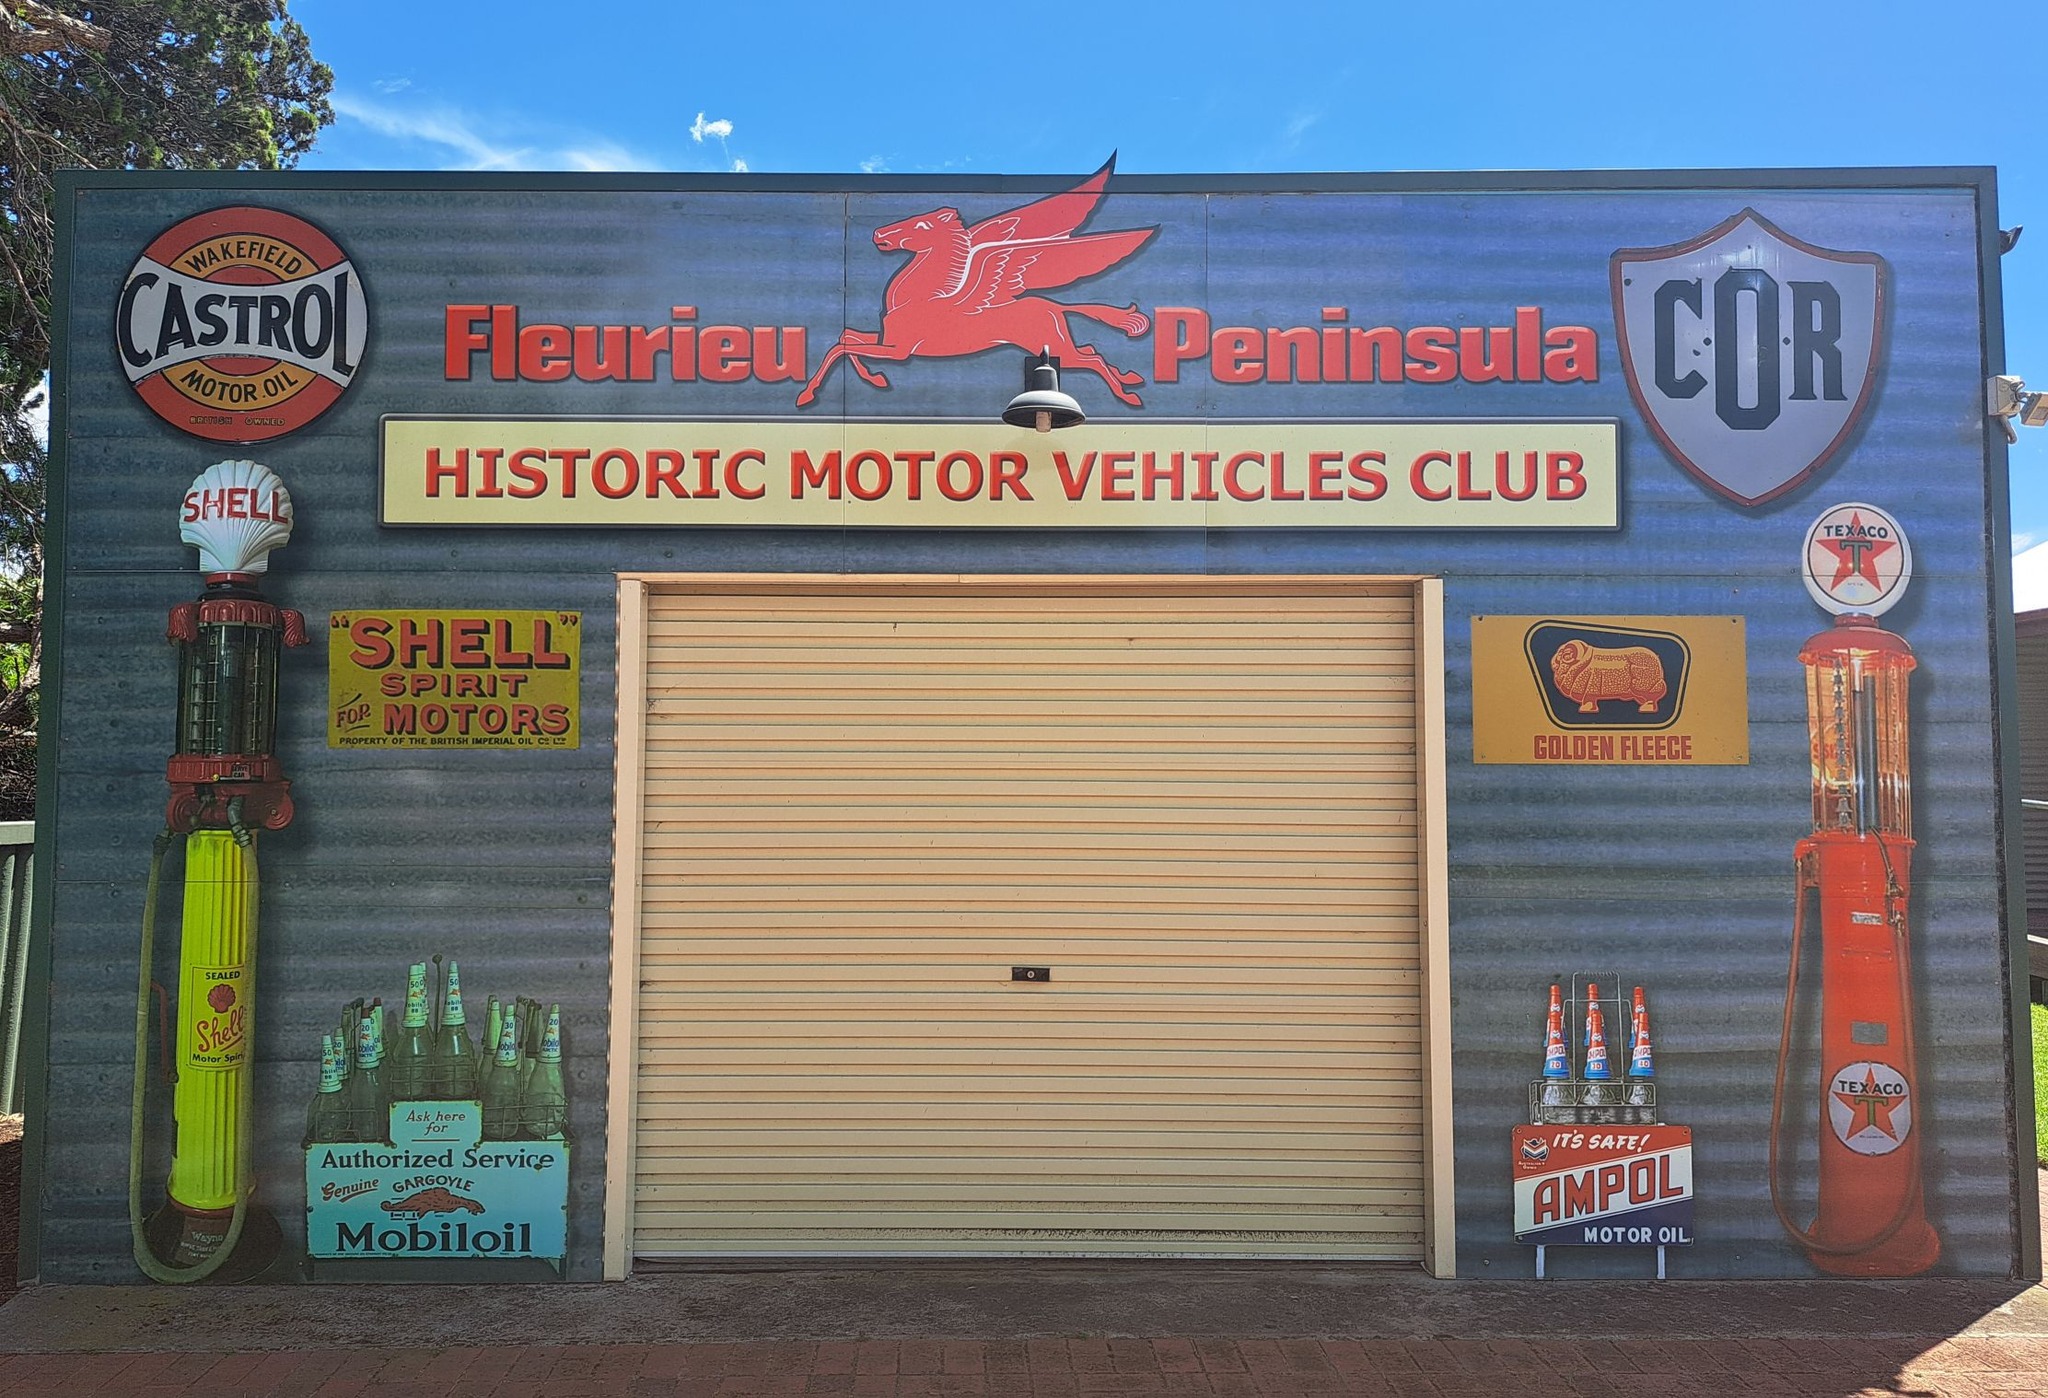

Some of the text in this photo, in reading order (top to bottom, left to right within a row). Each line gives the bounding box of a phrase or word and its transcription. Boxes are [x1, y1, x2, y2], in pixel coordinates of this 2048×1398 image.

[185, 241, 302, 275] WAKEFIELD
[118, 271, 355, 378] CASTROL
[444, 304, 1600, 386] Fleurieu Peninsula
[180, 369, 298, 403] MOTOR OIL
[190, 416, 285, 426] BRITISH OWNED
[424, 446, 1588, 502] HISTORIC MOTOR VEHICLES CLUB
[183, 487, 289, 524] SHELL
[1824, 525, 1888, 539] TEXACO
[380, 672, 528, 698] SPIRIT
[336, 702, 570, 735] FOR MOTORS
[339, 737, 388, 745] PROPERTY
[391, 737, 405, 745] OF
[408, 737, 427, 745] THE
[430, 737, 468, 745] BRITISH
[471, 737, 515, 745] IMPERIAL
[518, 737, 533, 745] OIL
[1534, 735, 1692, 760] GOLDEN FLEECE
[205, 971, 241, 980] SEALED
[196, 1005, 244, 1052] Shell
[504, 1022, 514, 1030] 30
[548, 1018, 559, 1026] 20
[192, 1053, 222, 1063] Motor
[1838, 1080, 1903, 1095] TEXACO
[406, 1109, 466, 1122] Ask here
[424, 1122, 448, 1136] for
[1552, 1129, 1651, 1153] IT'S SAFE!
[320, 1148, 555, 1169] Authorized Service
[321, 1174, 475, 1202] Genuine GARGOYLE
[1533, 1153, 1684, 1225] AMPOL
[336, 1222, 532, 1252] Mobiloil
[1584, 1227, 1687, 1243] MOTOR OIL
